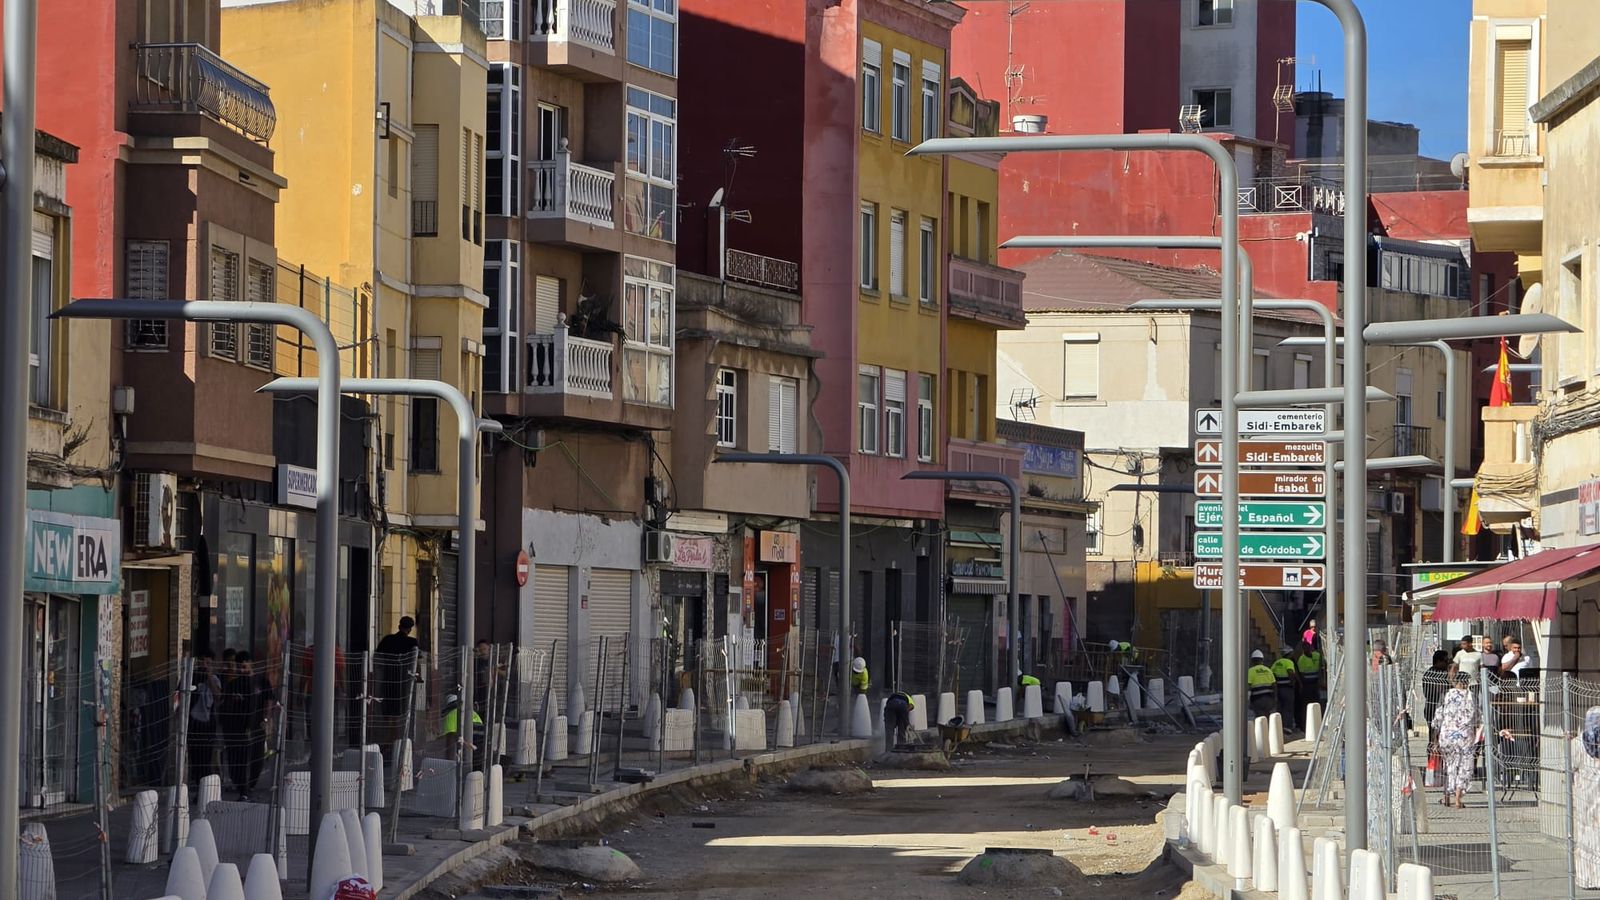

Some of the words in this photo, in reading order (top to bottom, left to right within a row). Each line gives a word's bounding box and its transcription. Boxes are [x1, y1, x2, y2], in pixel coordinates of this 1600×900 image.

[1247, 421, 1323, 431] Sidi-Embarek
[1285, 443, 1323, 452] mezquita
[1246, 452, 1323, 462] Sidi-Embarek
[1274, 483, 1309, 493] Isabel
[1315, 483, 1323, 493] II
[1199, 504, 1223, 512] aveni
[1249, 512, 1294, 523] Español
[33, 526, 72, 577] NEW
[77, 534, 108, 579] ERA
[1241, 545, 1254, 554] de
[1259, 545, 1302, 554] Córdoba
